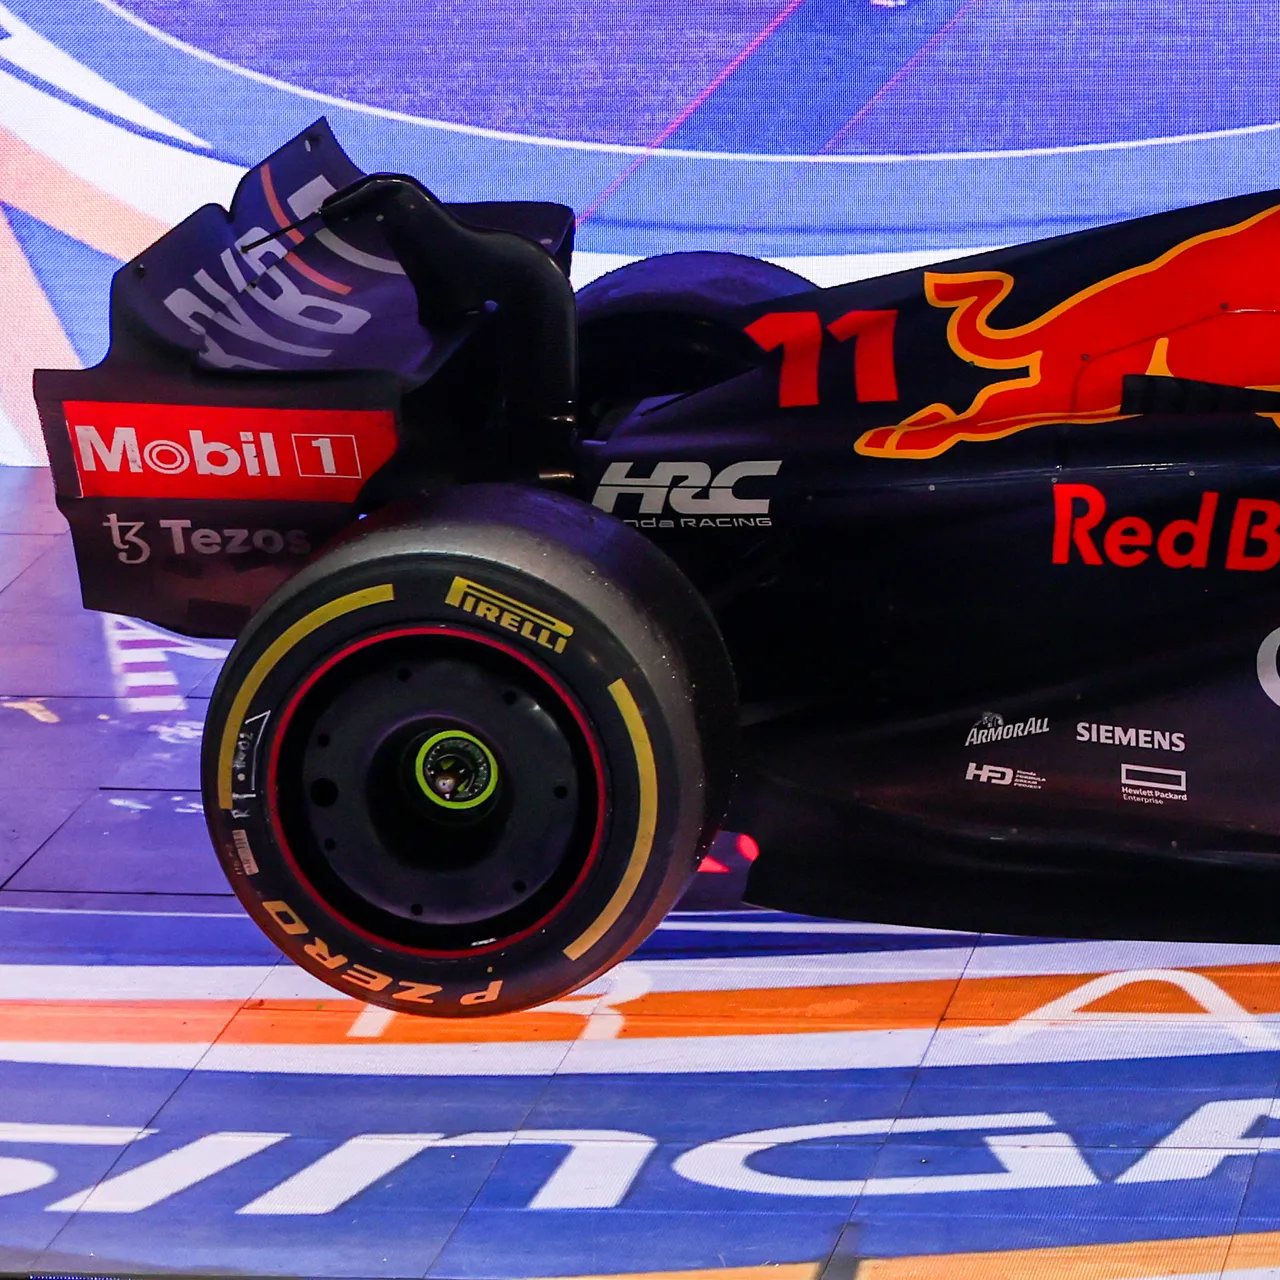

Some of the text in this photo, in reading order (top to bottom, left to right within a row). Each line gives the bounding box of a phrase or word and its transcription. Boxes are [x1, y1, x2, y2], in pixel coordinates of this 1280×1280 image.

[743, 309, 899, 408] 11
[75, 424, 281, 478] Mobil
[593, 460, 783, 515] HRC
[160, 518, 311, 556] Tezos
[680, 516, 773, 529] RACING
[1052, 483, 1220, 569] Red
[445, 575, 575, 654] PIRELLI
[1076, 722, 1186, 752] SIEMENS
[1121, 786, 1188, 801] Hewlett Packard
[261, 900, 504, 1006] P ZERO
